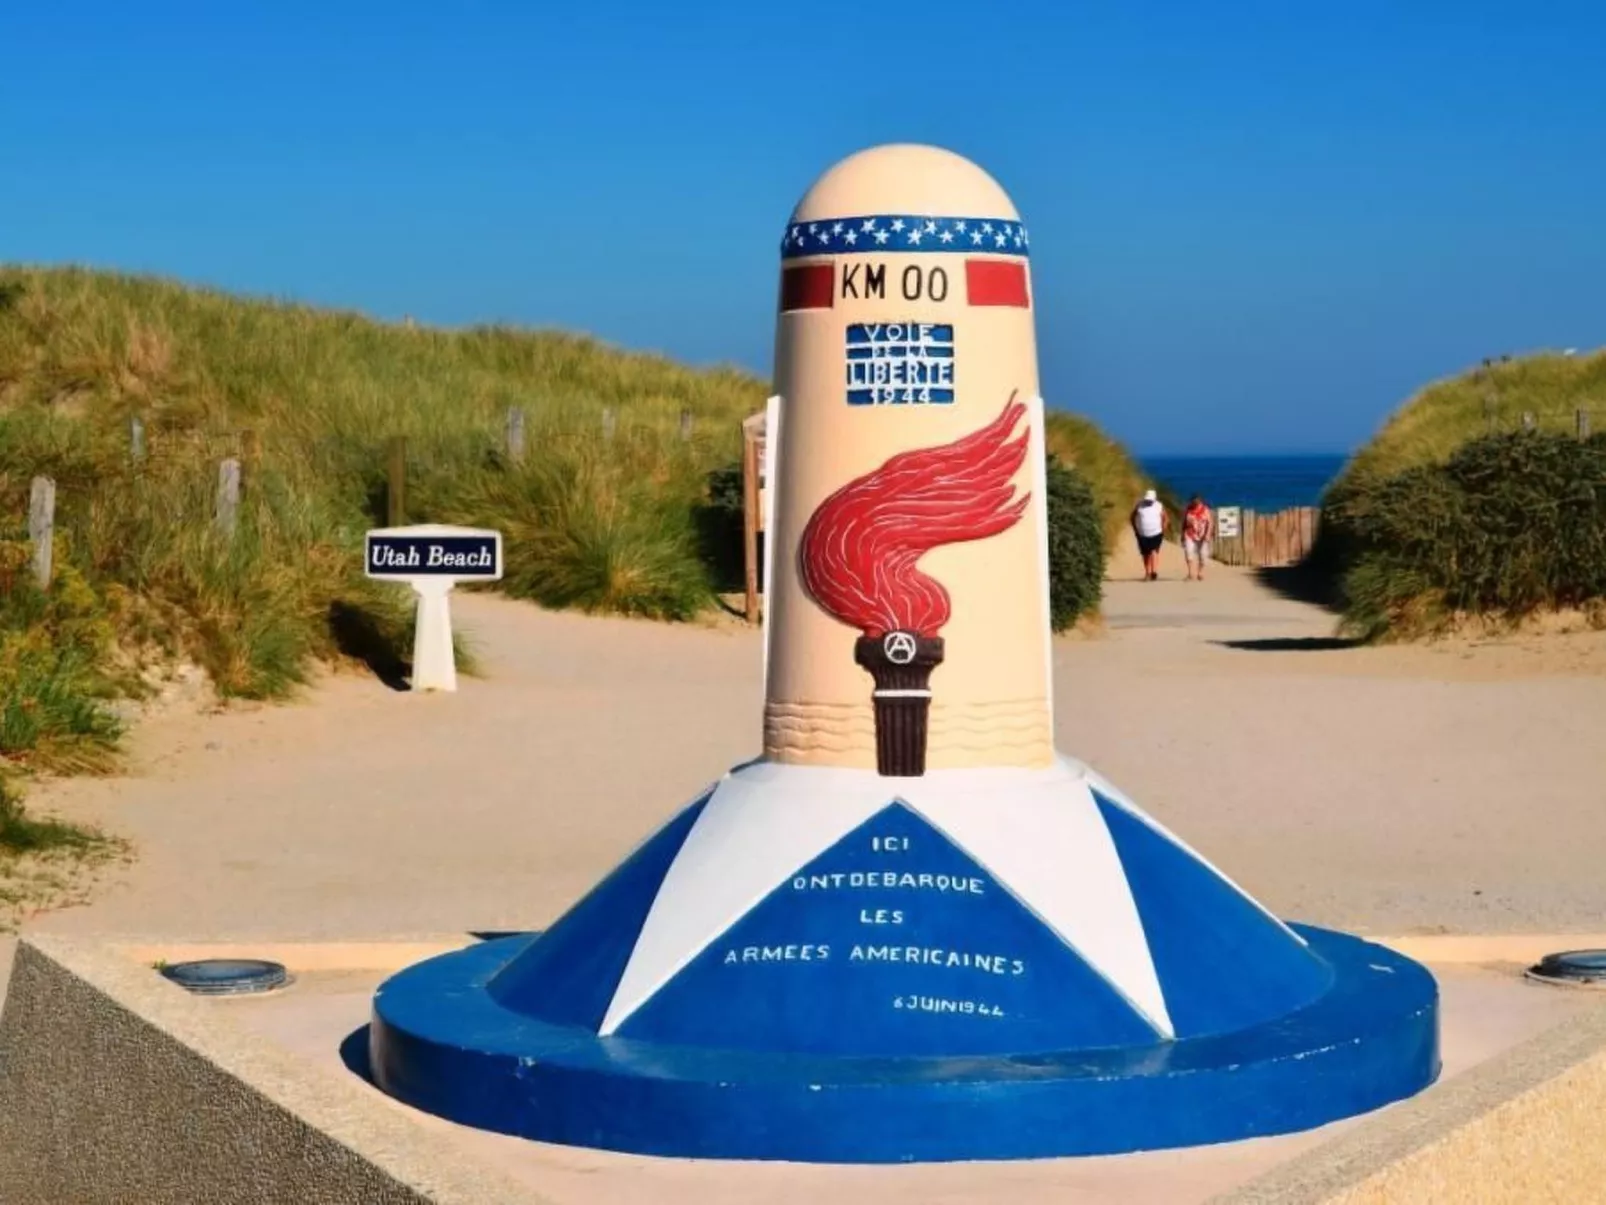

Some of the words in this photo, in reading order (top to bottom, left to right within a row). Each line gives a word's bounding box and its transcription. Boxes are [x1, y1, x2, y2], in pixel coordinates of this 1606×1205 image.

[841, 263, 886, 299] KM
[864, 324, 935, 343] VOIE
[850, 359, 953, 386] LIBERTE
[870, 387, 932, 405] 1944
[371, 545, 421, 567] Utah
[426, 545, 493, 567] Beach
[871, 836, 910, 852] ICI
[860, 909, 904, 924] LES
[724, 944, 831, 965] ARMEES
[849, 946, 1025, 975] AMERICAINES
